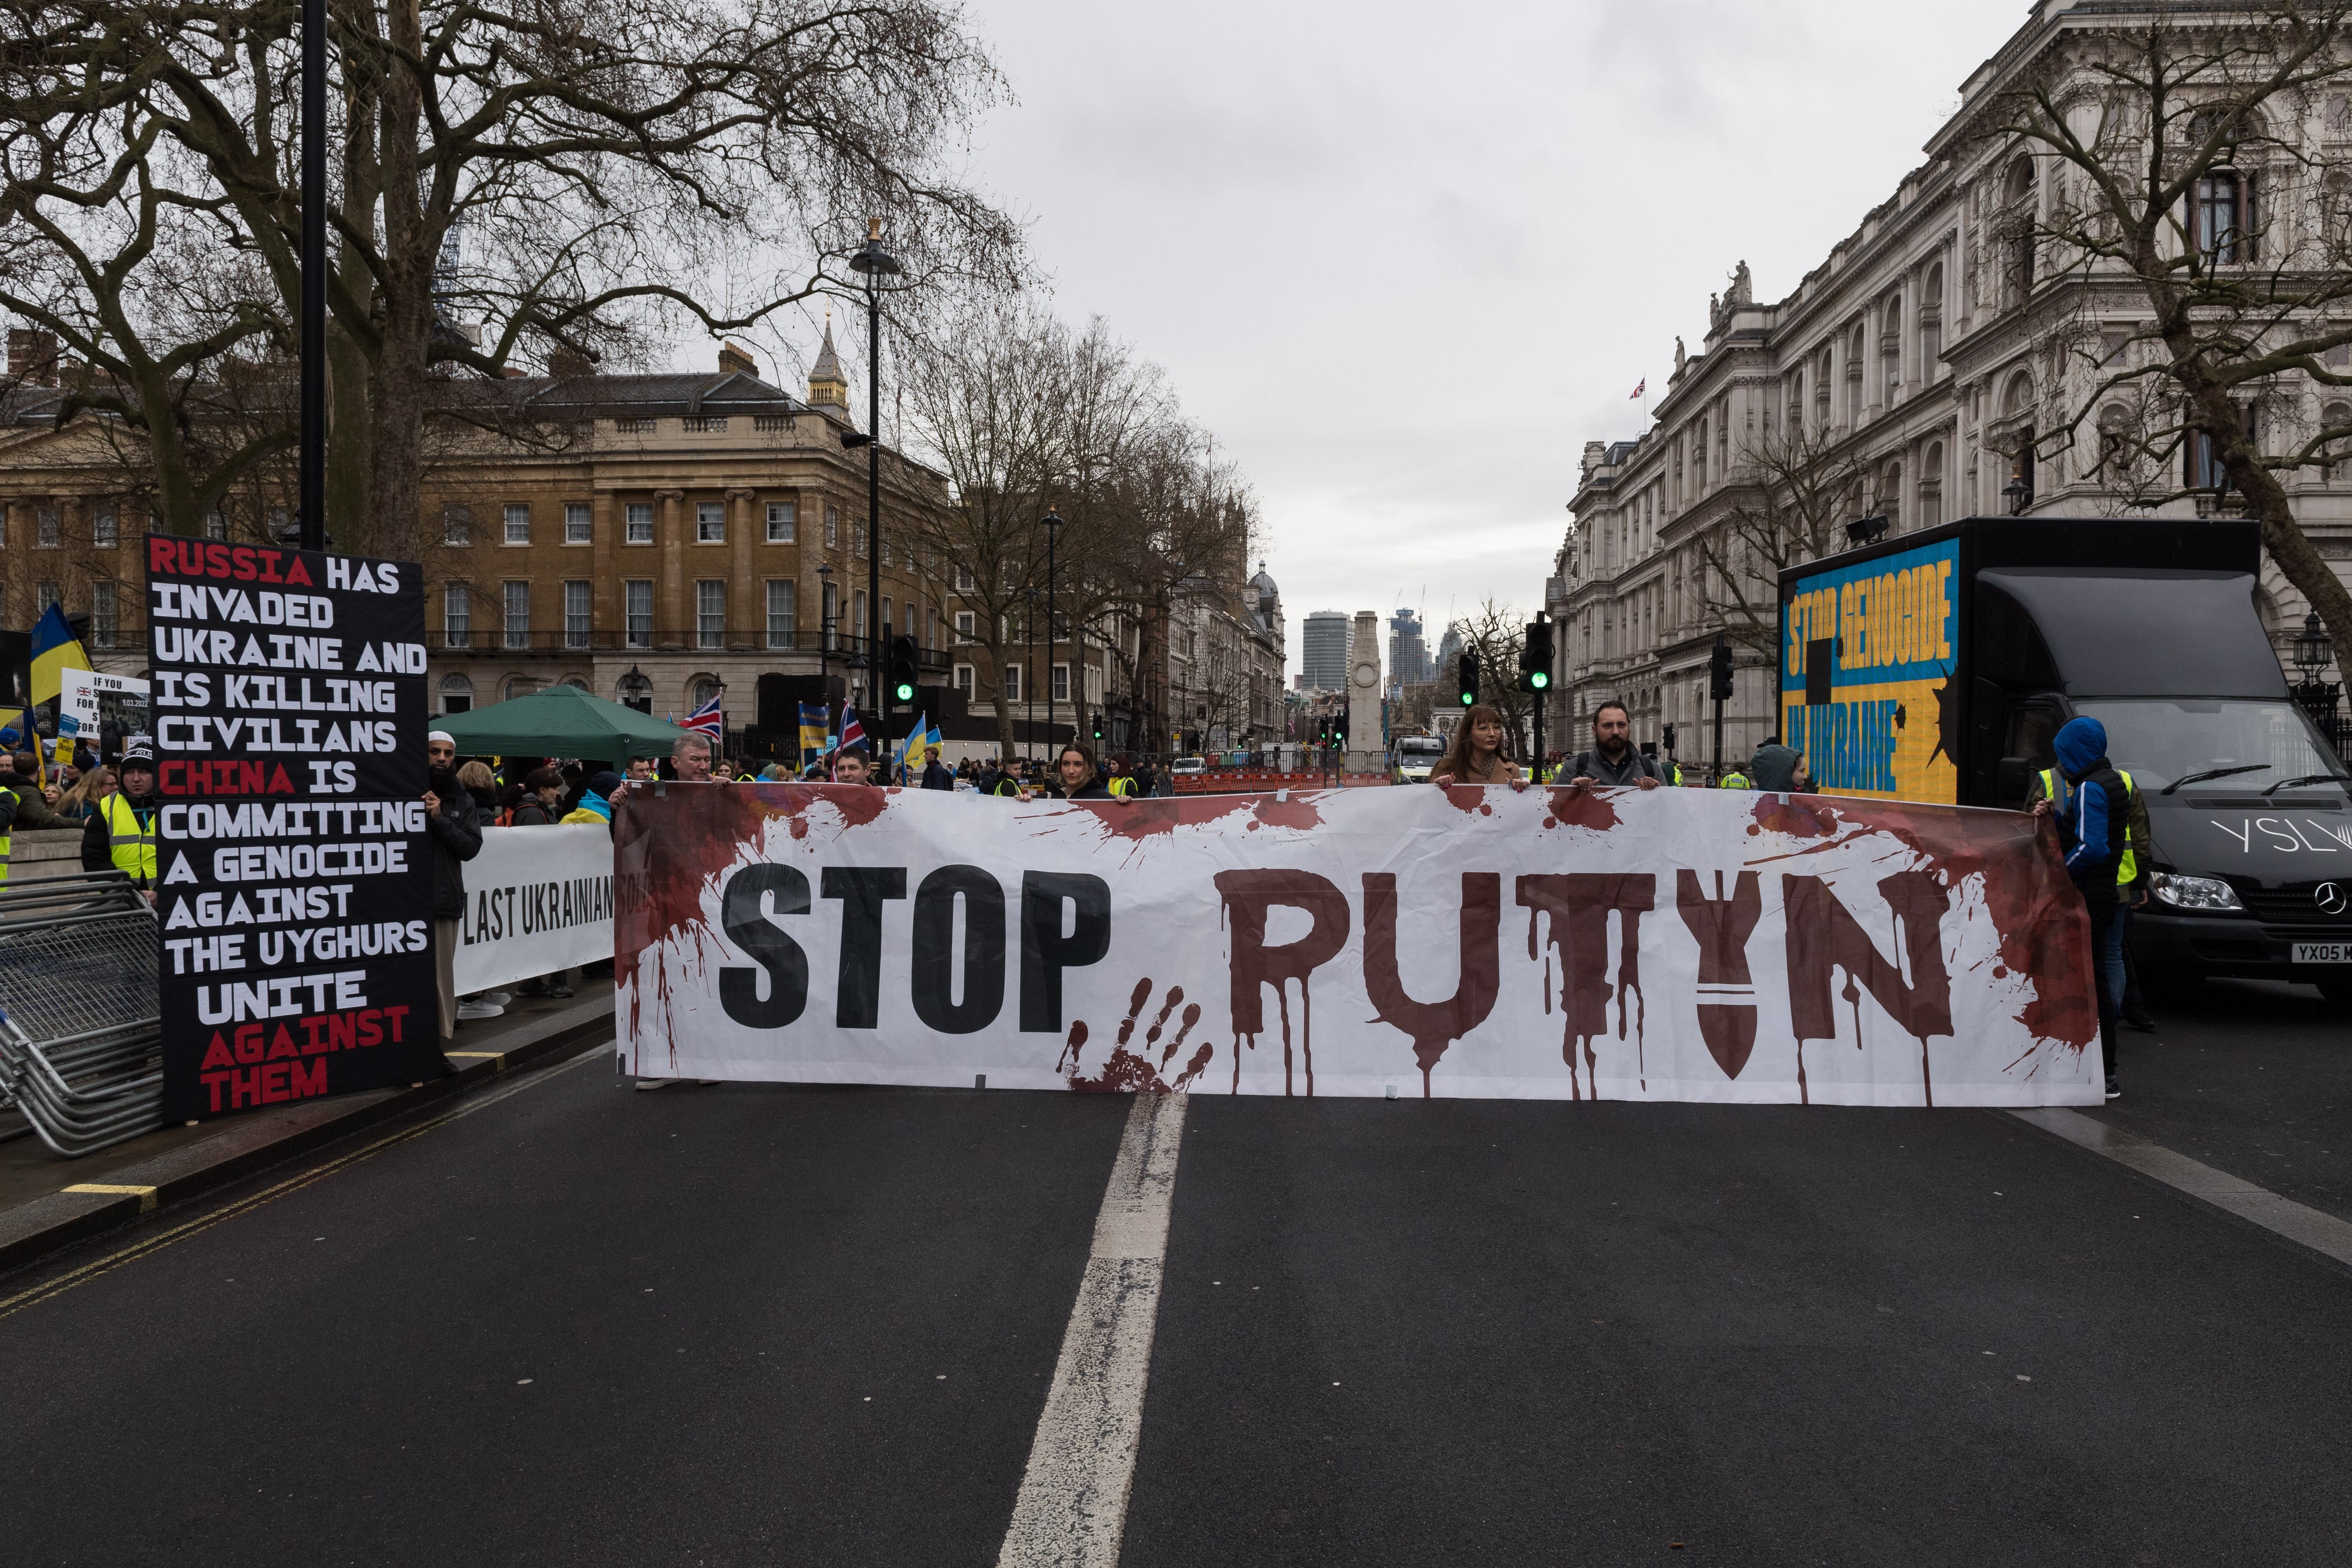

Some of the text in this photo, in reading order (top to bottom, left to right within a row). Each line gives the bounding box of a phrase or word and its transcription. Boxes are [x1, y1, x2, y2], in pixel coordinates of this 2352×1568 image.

[150, 537, 399, 594] RUSSIA HAS
[152, 582, 334, 629] INVADED
[1788, 559, 1952, 677] STOP GENOCIDE
[155, 626, 427, 674] UKRAINE AND
[77, 698, 94, 709] FOR
[94, 677, 122, 689] IF YOU
[122, 699, 148, 708] 9.03.2022
[155, 671, 395, 713] IS KILLING
[78, 722, 94, 733] FOR
[158, 716, 396, 752] CIVILIANS
[1809, 699, 1897, 792] UKRAINE
[159, 760, 356, 795] CHINA IS
[161, 801, 425, 839] COMMITTING
[163, 841, 408, 885] A GENOCIDE
[165, 884, 353, 930] AGAINST
[464, 886, 516, 946] LAST
[522, 875, 614, 935] UKRAINIAN
[165, 920, 427, 975] THE UYGHURS
[719, 863, 1111, 1034] STOP
[2299, 945, 2339, 960] YX05
[197, 969, 367, 1025] UNITE
[201, 1005, 408, 1070] AGAINST
[201, 1057, 327, 1112] THEM
